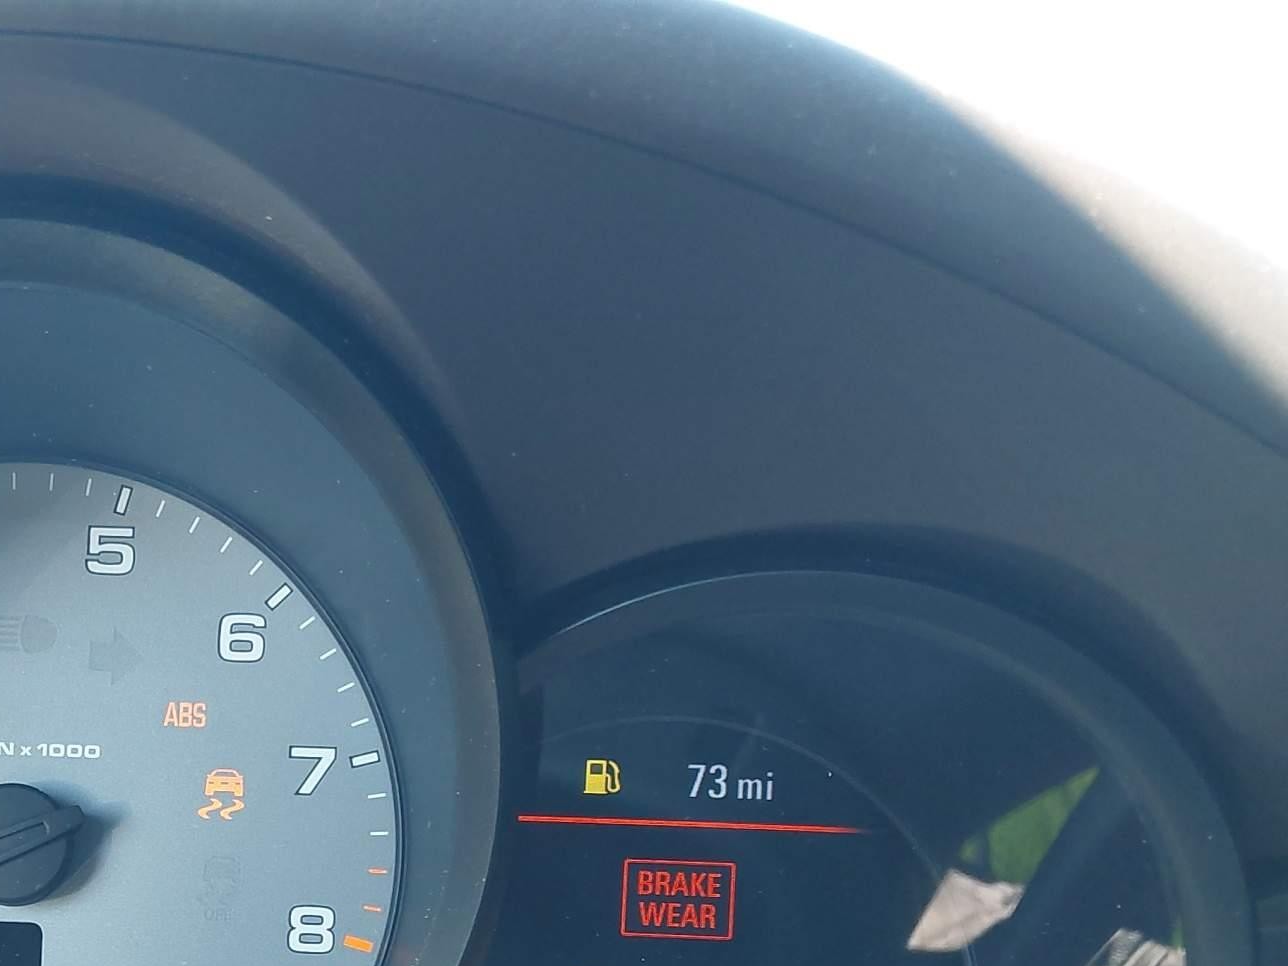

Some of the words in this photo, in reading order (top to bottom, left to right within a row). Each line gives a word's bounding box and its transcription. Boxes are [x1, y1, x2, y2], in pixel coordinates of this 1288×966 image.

[85, 525, 136, 575] 5
[217, 612, 267, 662] 6
[163, 702, 208, 729] ABS
[36, 743, 102, 759] 1000
[289, 746, 337, 796] 7
[687, 764, 727, 799] 73
[736, 772, 775, 800] mi
[637, 870, 722, 898] BRAKE
[287, 904, 336, 955] 8
[638, 901, 717, 929] WEAR
